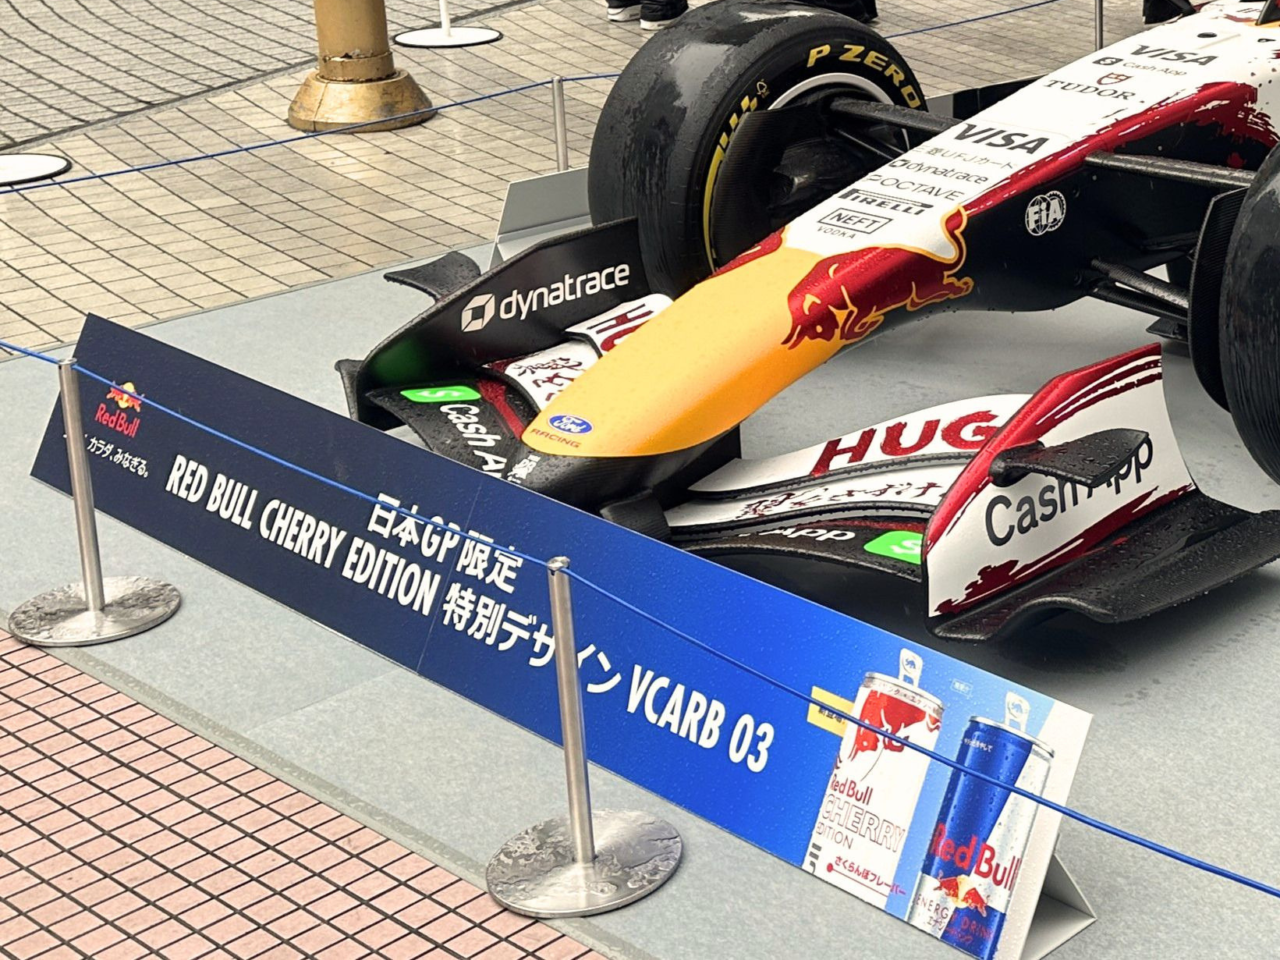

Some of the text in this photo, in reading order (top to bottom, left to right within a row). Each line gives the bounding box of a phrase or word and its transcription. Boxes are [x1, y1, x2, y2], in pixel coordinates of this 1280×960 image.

[1130, 44, 1218, 66] VISA
[807, 44, 922, 109] P ZERO
[1044, 78, 1136, 101] TUDOR
[953, 122, 1051, 155] VISA
[880, 176, 965, 201] OCTAVE
[905, 161, 989, 185] dynatrace
[838, 188, 934, 216] PIRELLI
[829, 210, 880, 230] NEFT
[499, 263, 630, 321] dynatrace
[94, 403, 141, 438] Red Bull
[984, 476, 1080, 547] Cash
[164, 453, 210, 504] RED
[205, 473, 259, 530] BULL
[259, 498, 348, 570] CHERRY
[341, 532, 441, 617] EDITION
[626, 663, 726, 750] VCARB
[728, 713, 776, 774] 03
[846, 780, 873, 806] Bull
[821, 793, 907, 854] CHERRY
[930, 823, 1023, 892] Red Bull
